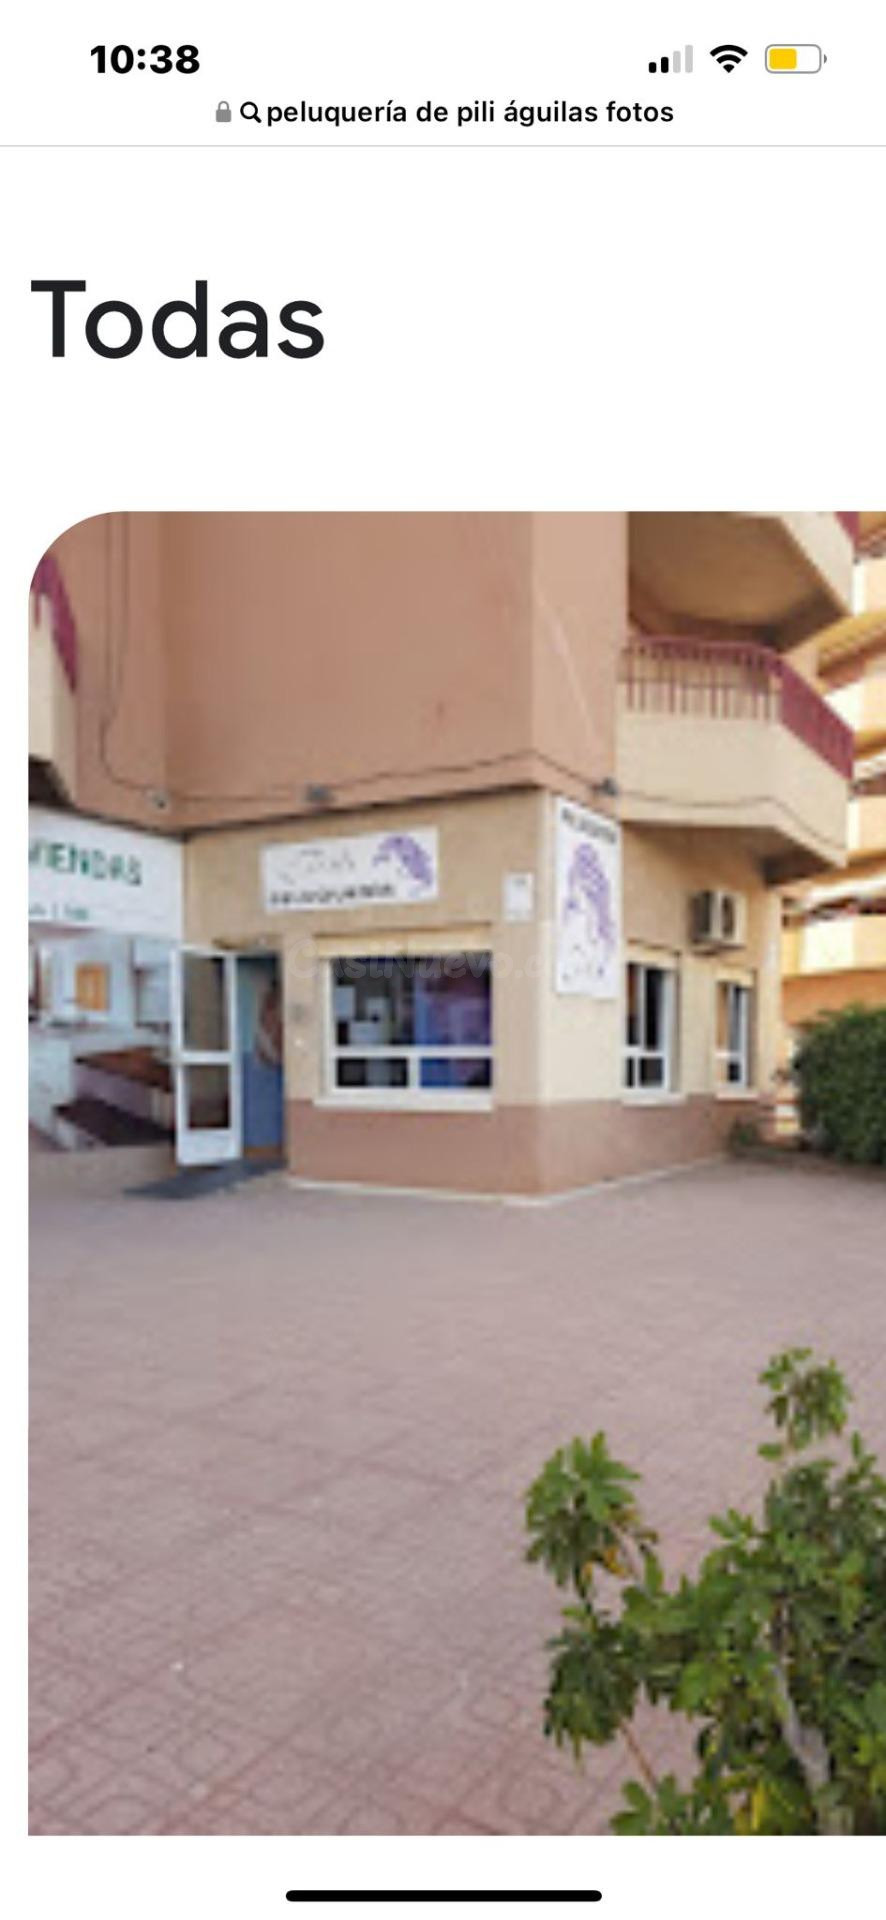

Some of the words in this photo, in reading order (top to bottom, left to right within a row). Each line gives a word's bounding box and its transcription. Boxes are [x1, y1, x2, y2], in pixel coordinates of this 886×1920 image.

[90, 44, 200, 75] 10:38
[267, 99, 407, 127] peluquería
[416, 100, 449, 123] de
[457, 100, 495, 127] pili
[503, 99, 598, 128] águilas
[605, 100, 674, 123] fotos
[30, 279, 325, 360] Todas
